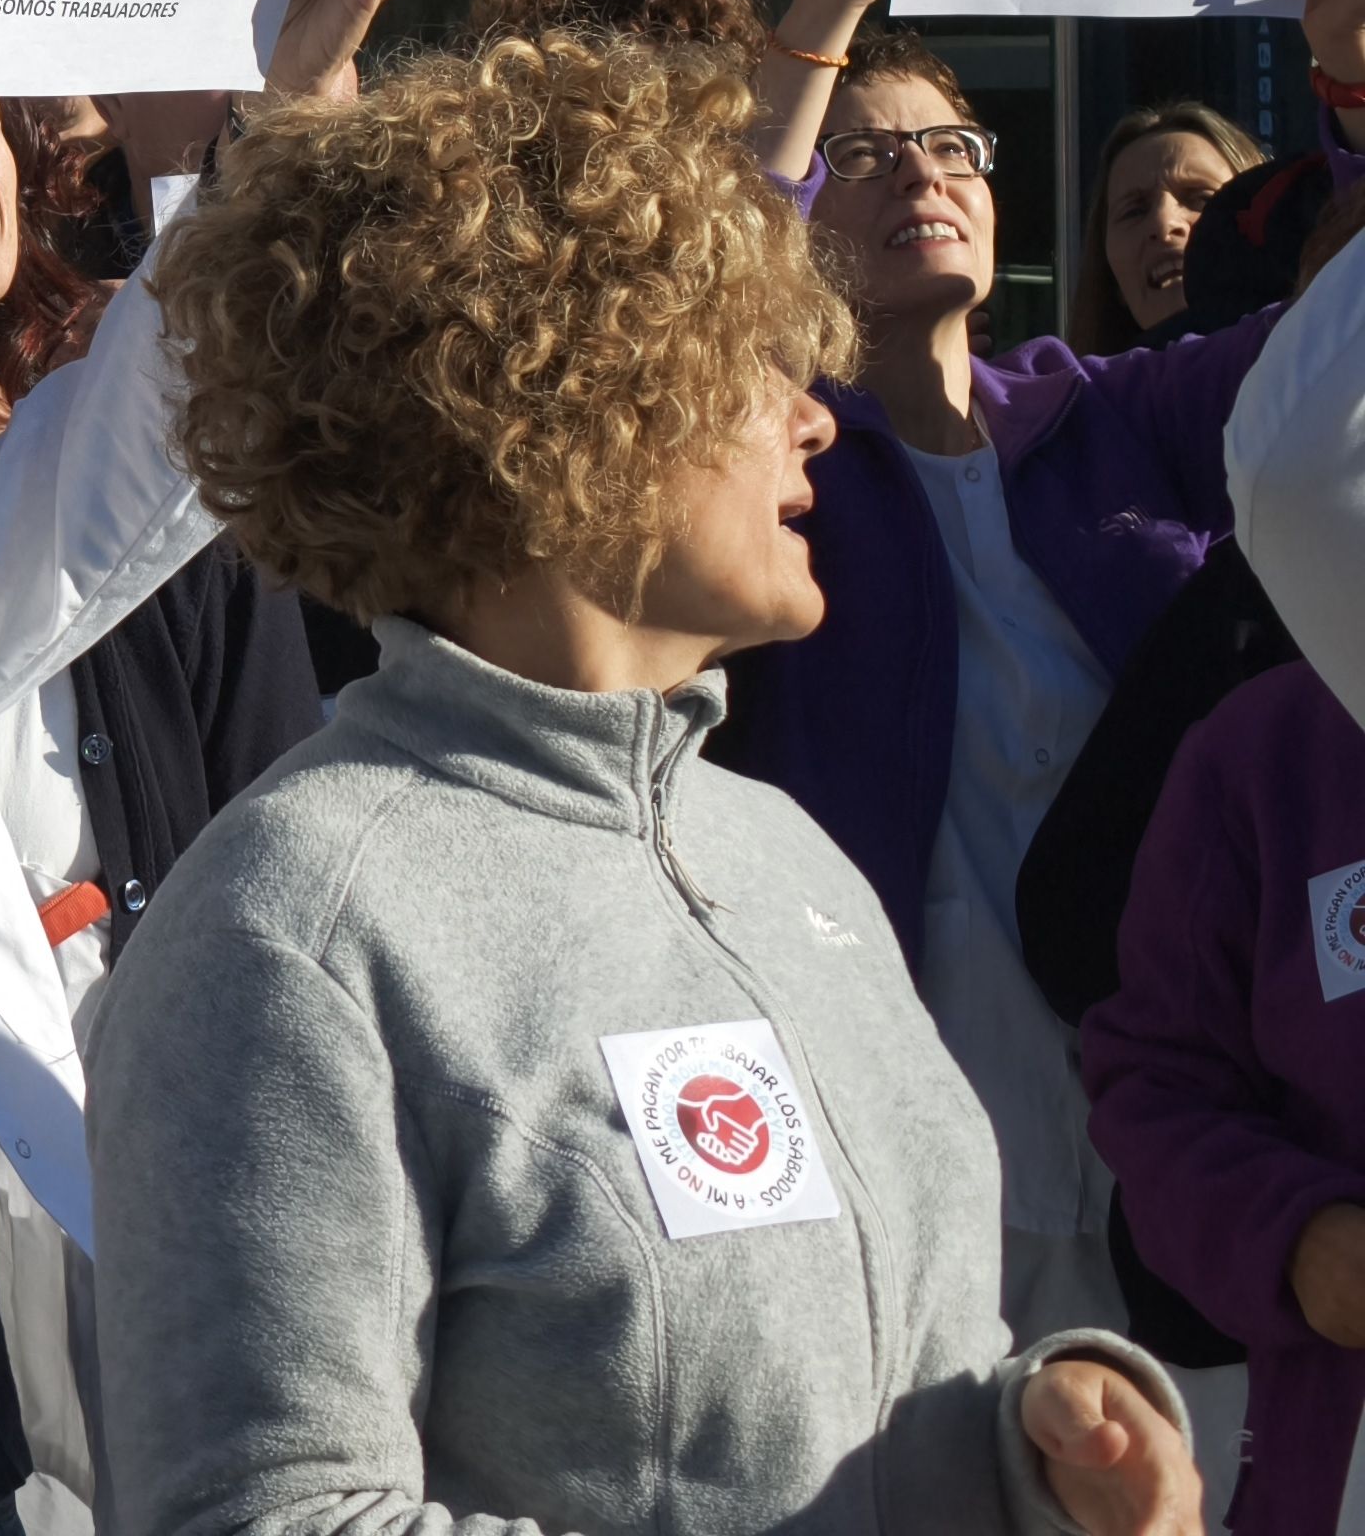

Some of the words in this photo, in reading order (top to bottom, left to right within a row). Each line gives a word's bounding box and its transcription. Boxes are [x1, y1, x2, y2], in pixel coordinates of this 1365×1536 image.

[62, 1, 179, 18] TRABAJADORES
[1325, 888, 1348, 931] PAGAN
[1326, 932, 1342, 952] ME
[1338, 949, 1355, 966] NO
[656, 1041, 689, 1071] POR
[689, 1037, 779, 1091] TBAJAR
[642, 1067, 663, 1130] PAGAN
[775, 1092, 801, 1130] LOS
[652, 1135, 678, 1165] ME
[677, 1166, 703, 1192] NO
[761, 1135, 809, 1207] SÁBADOS
[734, 1193, 745, 1209] A
